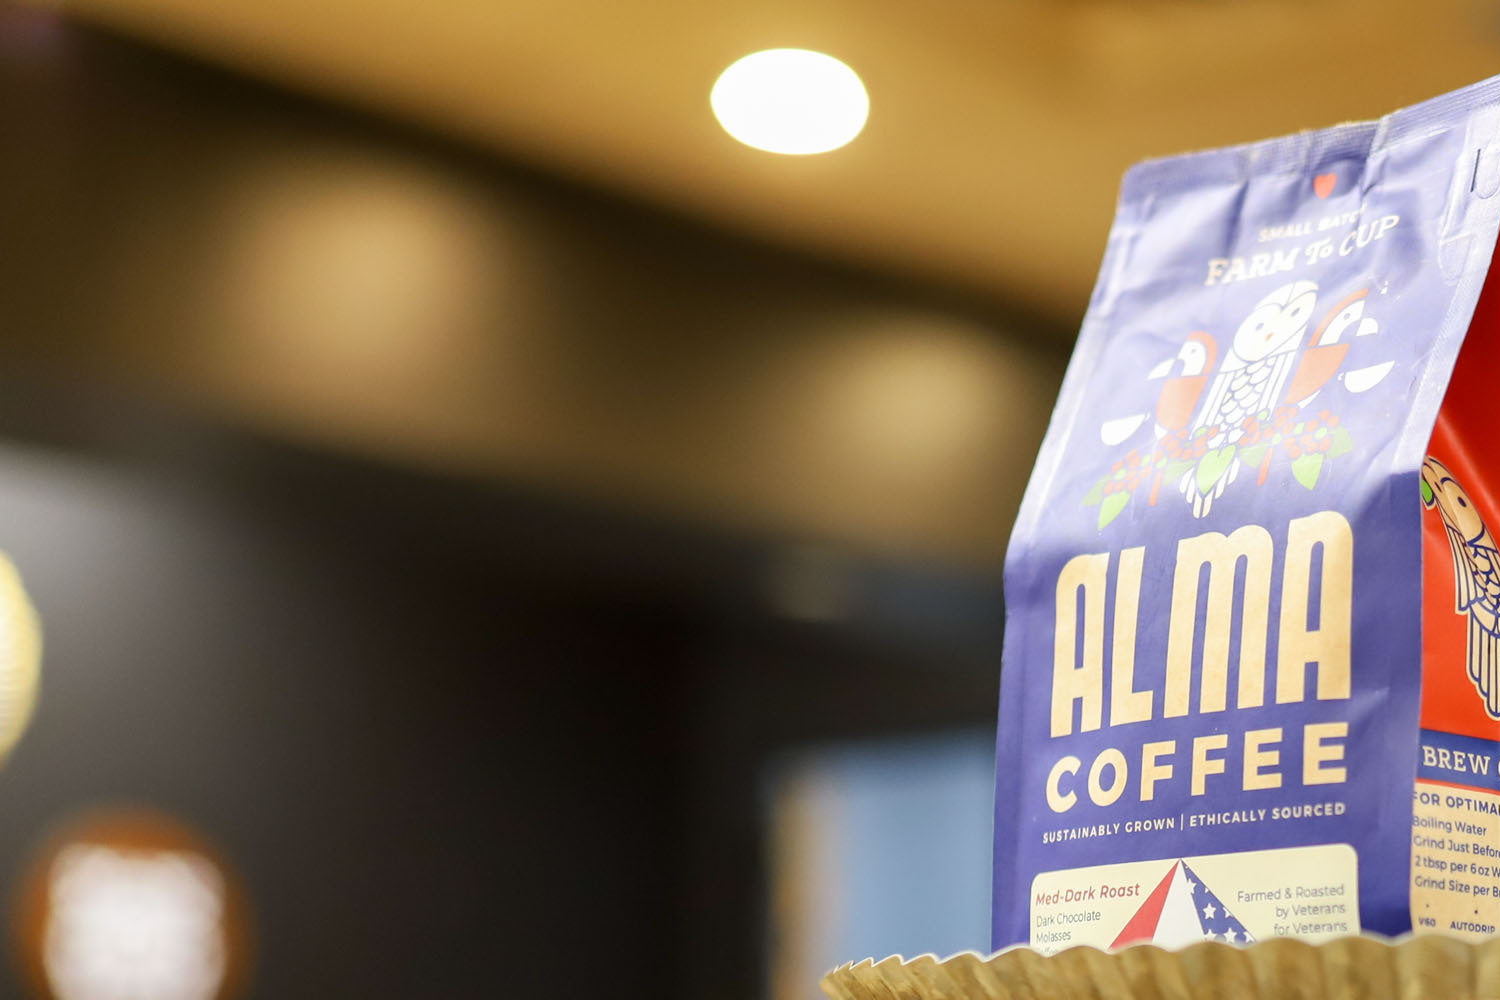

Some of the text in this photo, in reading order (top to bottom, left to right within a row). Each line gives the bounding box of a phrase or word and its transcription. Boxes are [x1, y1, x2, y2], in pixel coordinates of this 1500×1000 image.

[1259, 222, 1312, 242] SMALL
[1204, 215, 1400, 286] FARM To CUP
[1049, 510, 1354, 738] ALMA
[1045, 721, 1349, 813] COFFEE
[1422, 745, 1491, 775] BREW
[1043, 802, 1346, 844] SUSTAINABLY GROWN ETHICALLY SOURCED
[1413, 816, 1487, 836] Boiling Water
[1413, 835, 1445, 849] Grind
[1448, 841, 1470, 854] Just
[1423, 856, 1447, 871] tbsp
[1450, 862, 1467, 873] per
[1036, 883, 1141, 906] Med-Dark Roast
[1237, 884, 1344, 903] Farmed & Roasted
[1415, 876, 1445, 890] Grind
[1448, 880, 1470, 893] Size
[1473, 885, 1490, 897] per
[1036, 910, 1101, 927] Dark Chocolate
[1276, 904, 1345, 919] by Veterans
[1036, 931, 1071, 943] Molasses
[1274, 922, 1348, 936] for Veterans
[1450, 921, 1495, 934] AUTODRIP
